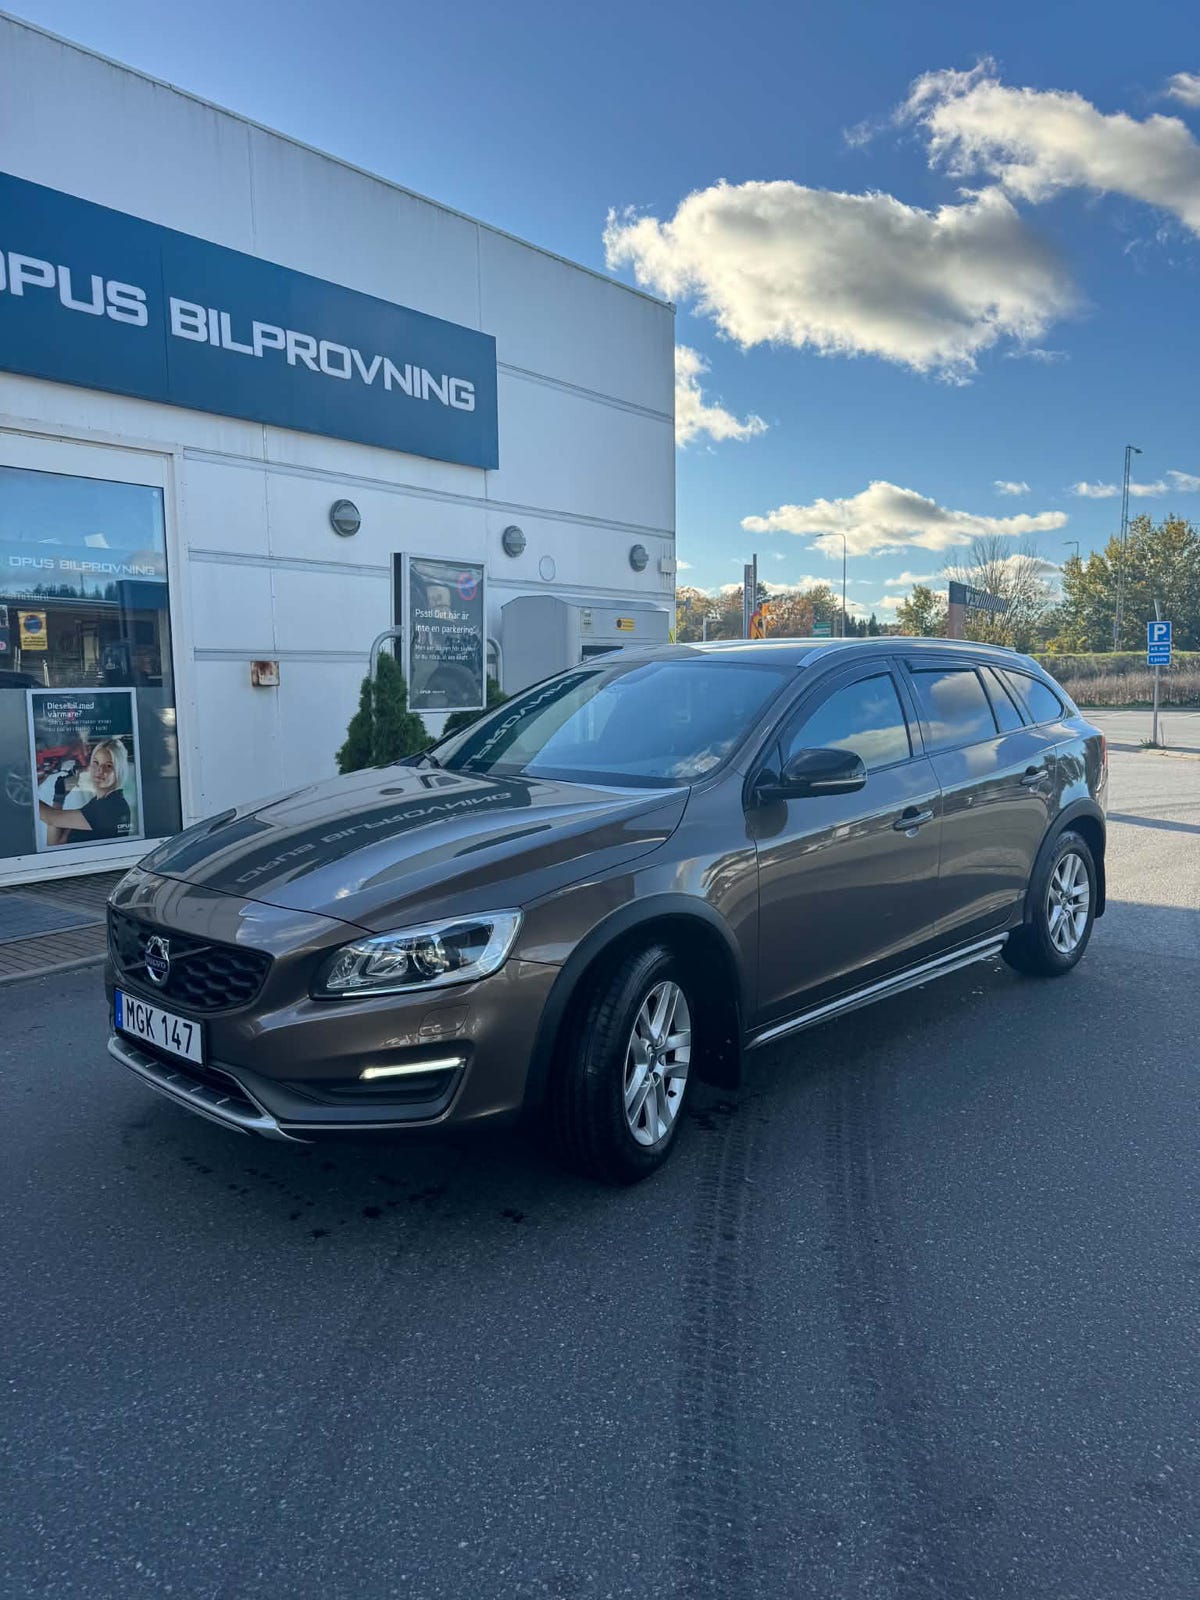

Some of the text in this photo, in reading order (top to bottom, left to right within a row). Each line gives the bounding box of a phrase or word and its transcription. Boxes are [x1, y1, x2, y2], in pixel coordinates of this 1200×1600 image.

[0, 251, 476, 412] PUS BILPROVNING
[9, 556, 156, 576] OPUS BILPROVNING
[461, 611, 470, 620] är
[415, 624, 430, 632] inte
[431, 625, 440, 633] en
[1153, 623, 1167, 641] P
[126, 998, 193, 1054] MGK 147
